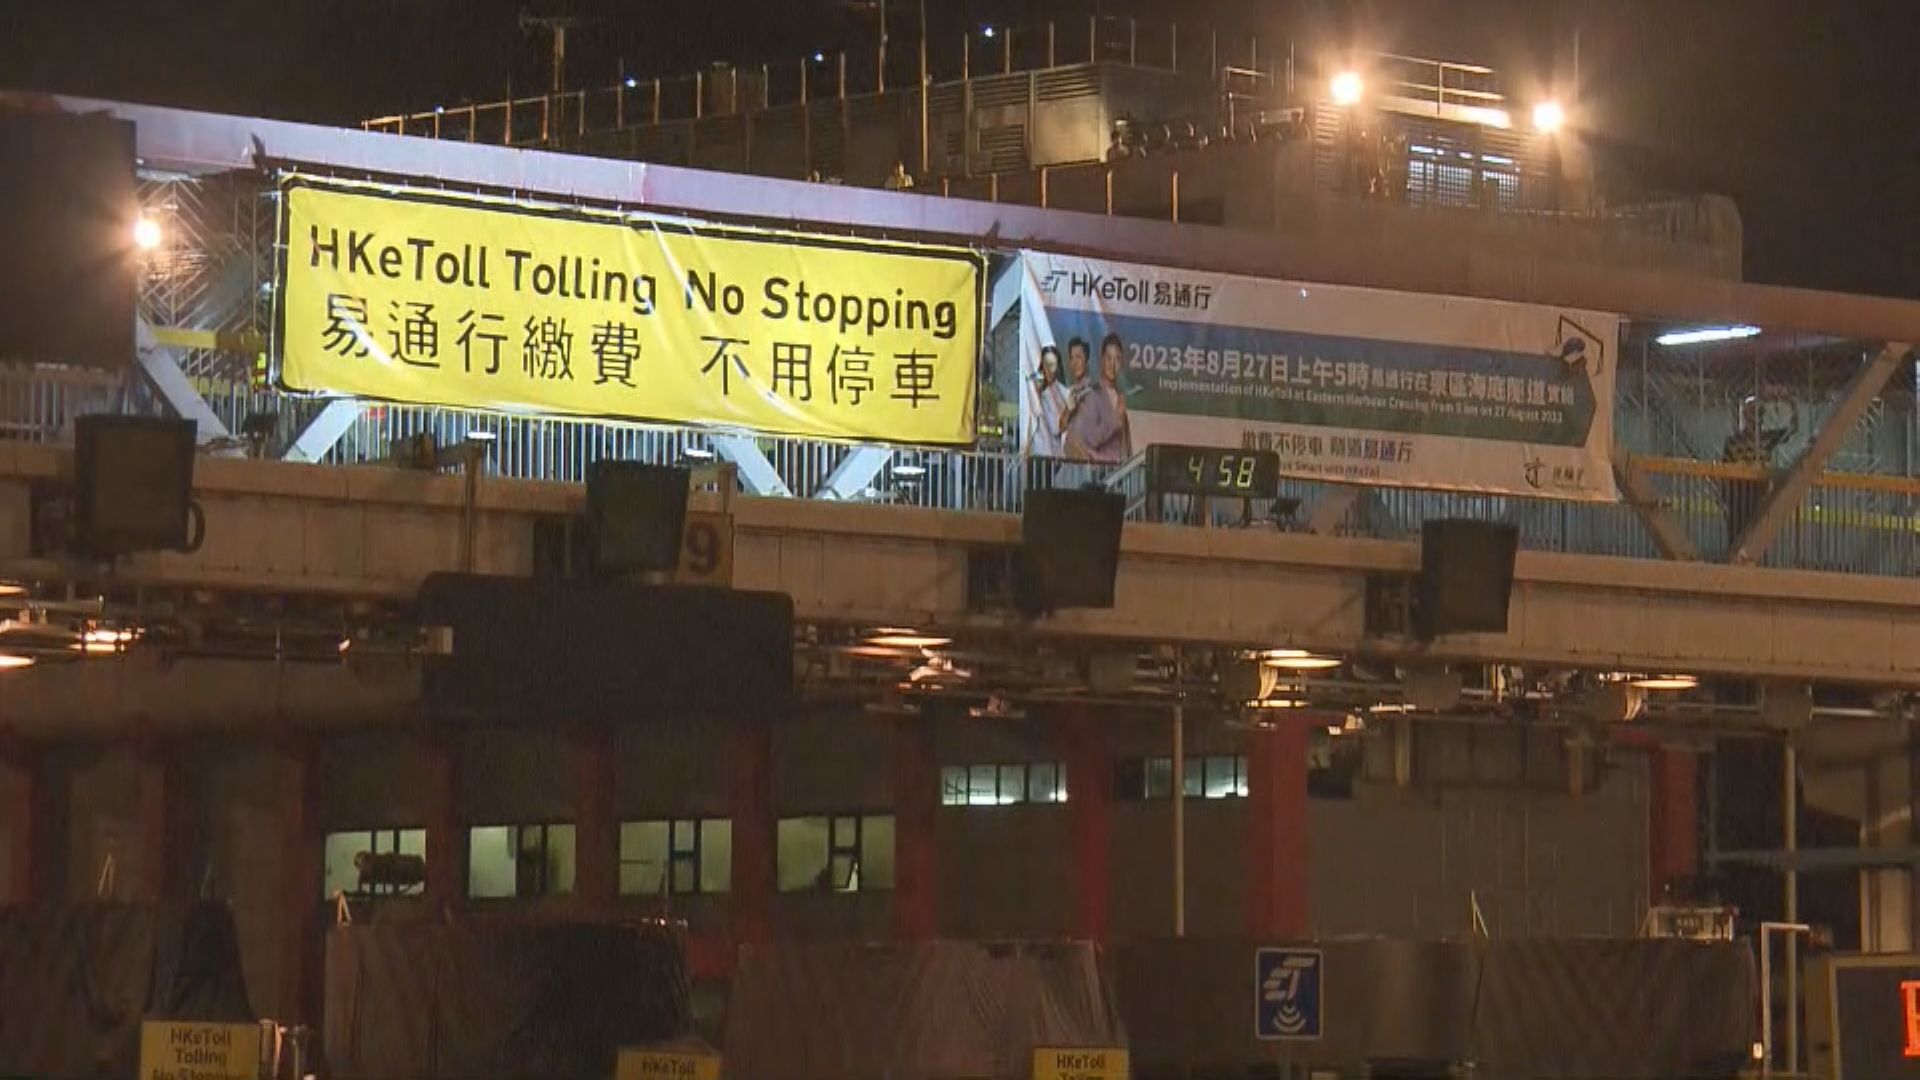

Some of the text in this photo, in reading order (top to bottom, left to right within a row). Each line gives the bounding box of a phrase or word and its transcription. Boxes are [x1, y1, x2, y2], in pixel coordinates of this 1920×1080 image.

[311, 225, 956, 339] HKeToll Tolling No Stopping
[1071, 271, 1148, 304] HKeToll
[1154, 281, 1212, 309] 易通行
[322, 293, 950, 409] 易通行繳費 不用停車
[685, 521, 722, 576] 9
[171, 1028, 231, 1046] HKeToll
[176, 1048, 228, 1066] Tolling
